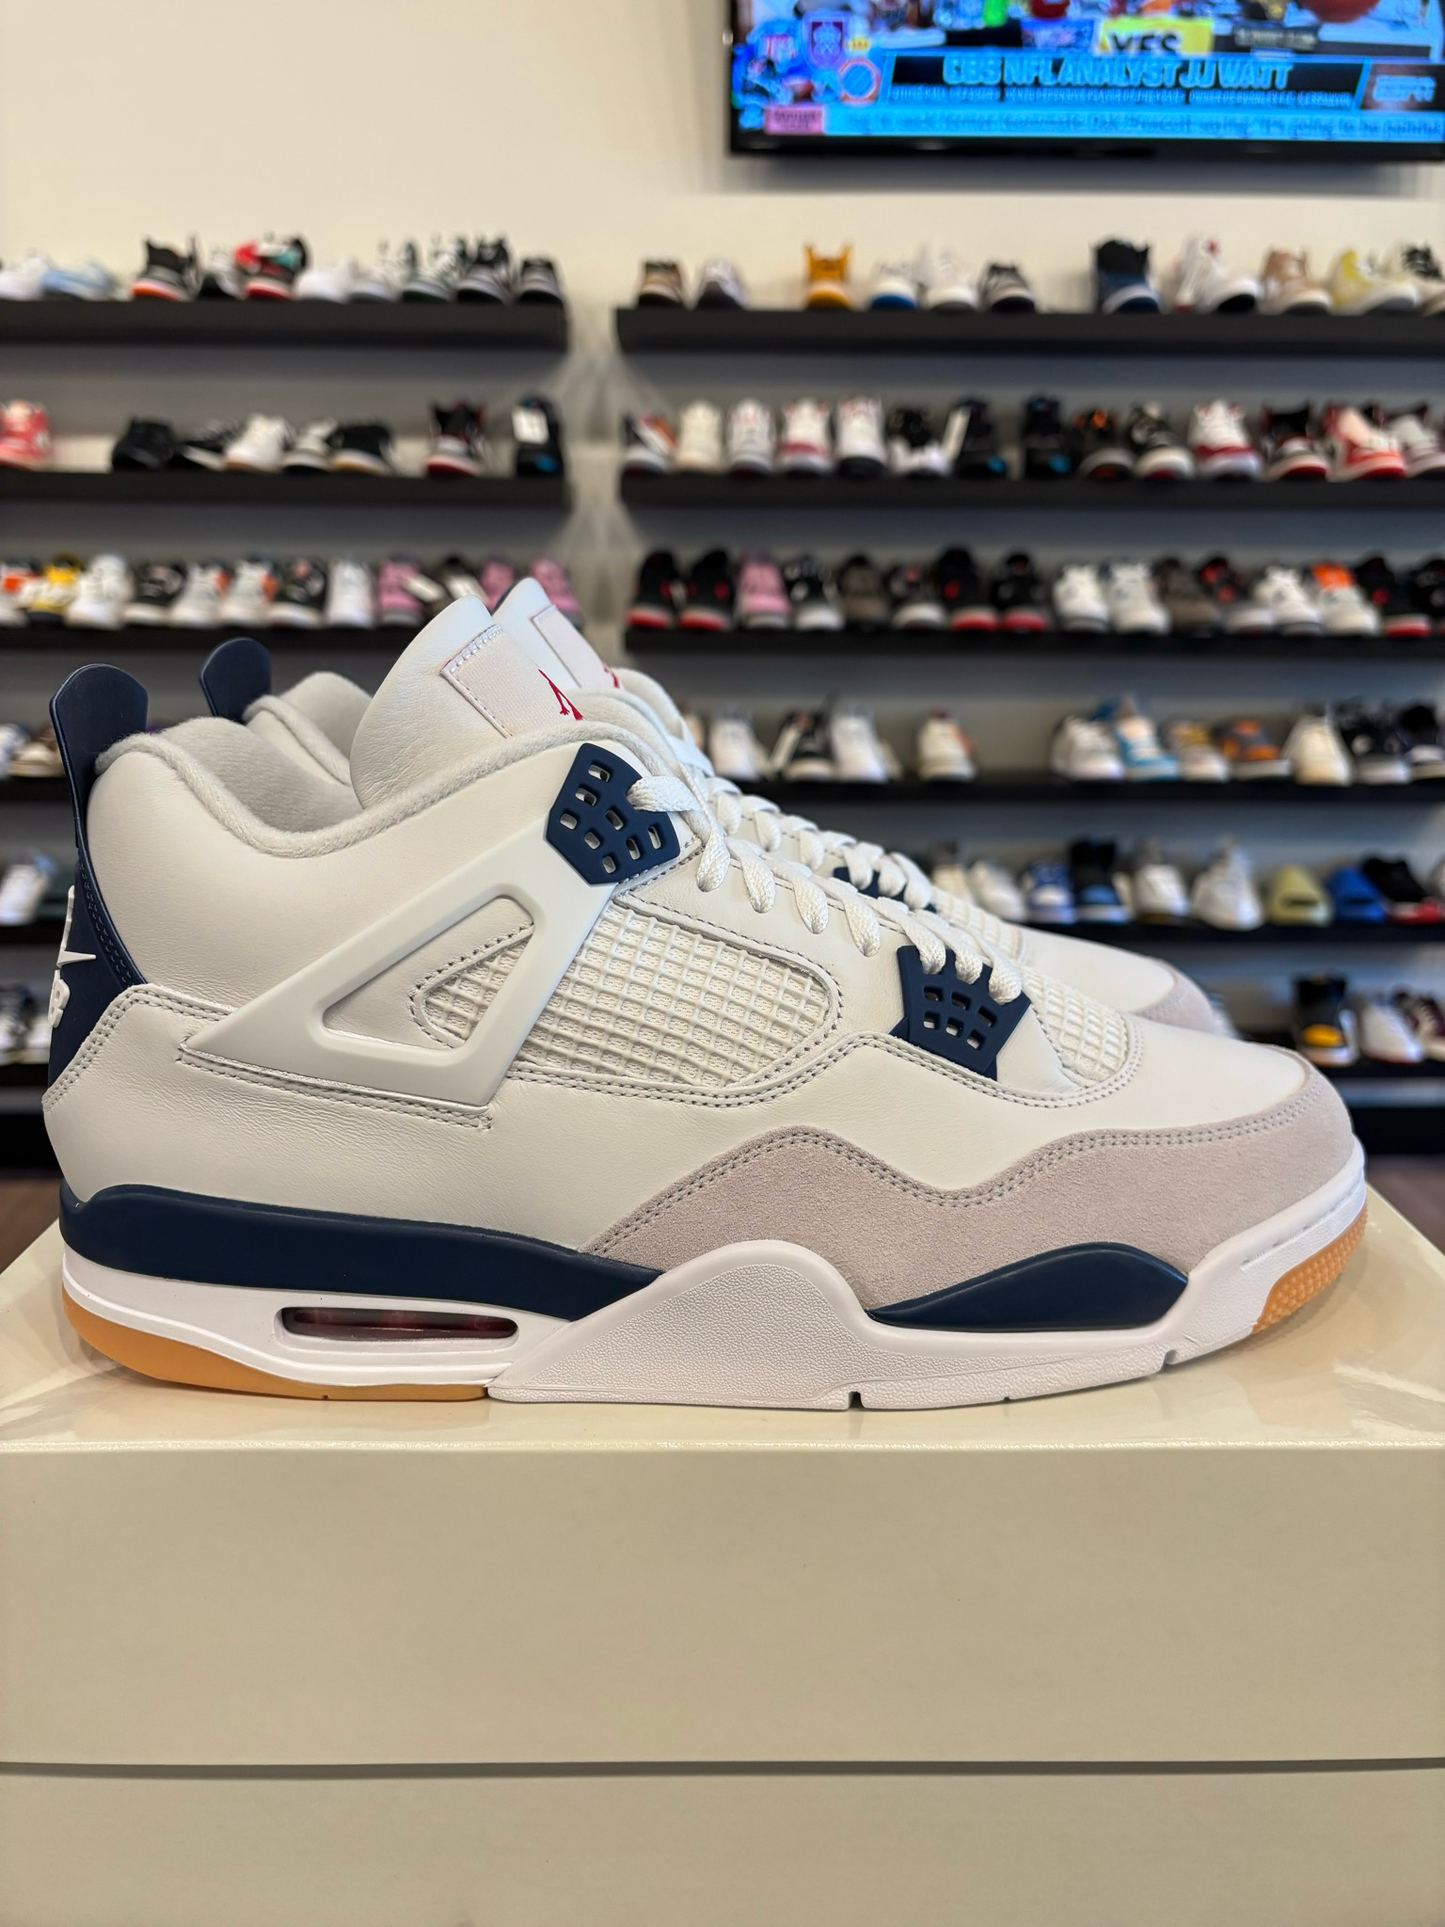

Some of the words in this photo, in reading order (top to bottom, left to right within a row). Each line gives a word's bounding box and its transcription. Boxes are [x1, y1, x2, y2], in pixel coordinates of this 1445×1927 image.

[1003, 56, 1056, 86] NFL
[1057, 57, 1182, 88] ANALYST
[1178, 58, 1216, 89] JJ
[1217, 59, 1293, 89] WATT
